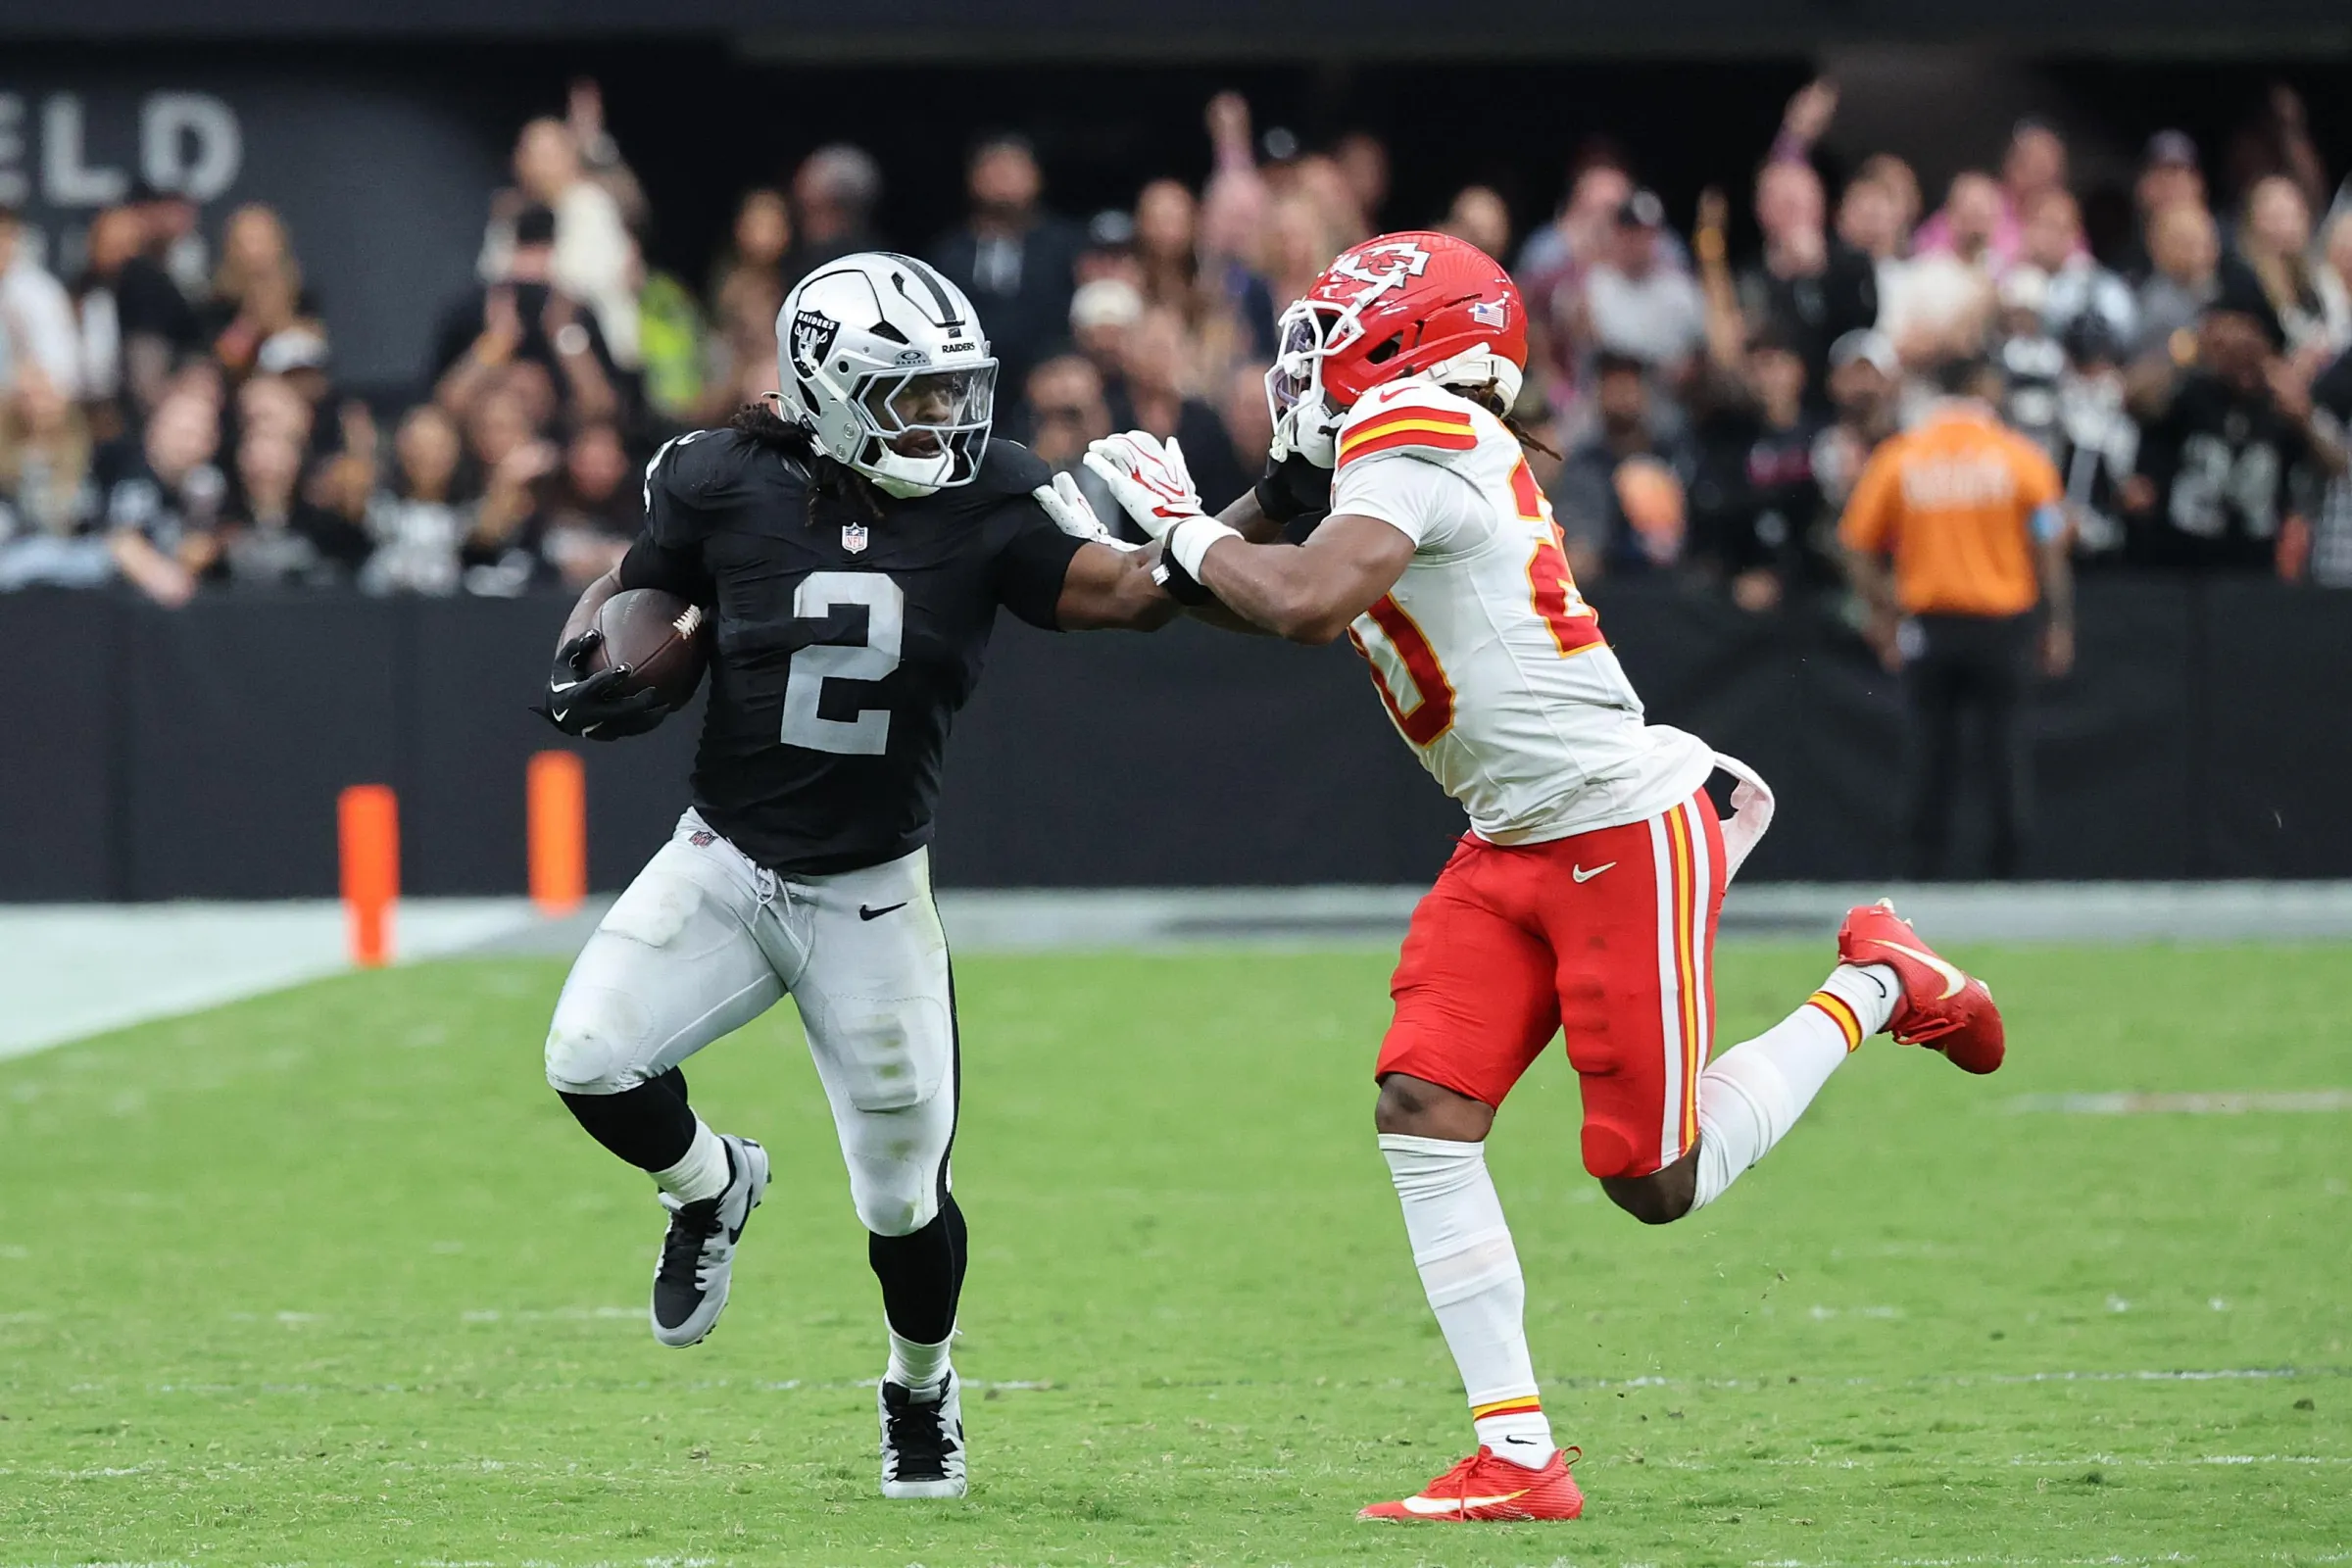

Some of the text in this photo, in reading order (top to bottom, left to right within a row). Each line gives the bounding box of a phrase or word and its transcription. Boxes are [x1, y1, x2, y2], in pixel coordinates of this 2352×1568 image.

[798, 313, 836, 330] RAIDERS
[942, 342, 975, 354] RAIDERS
[847, 536, 864, 548] NFL
[780, 571, 904, 756] 2
